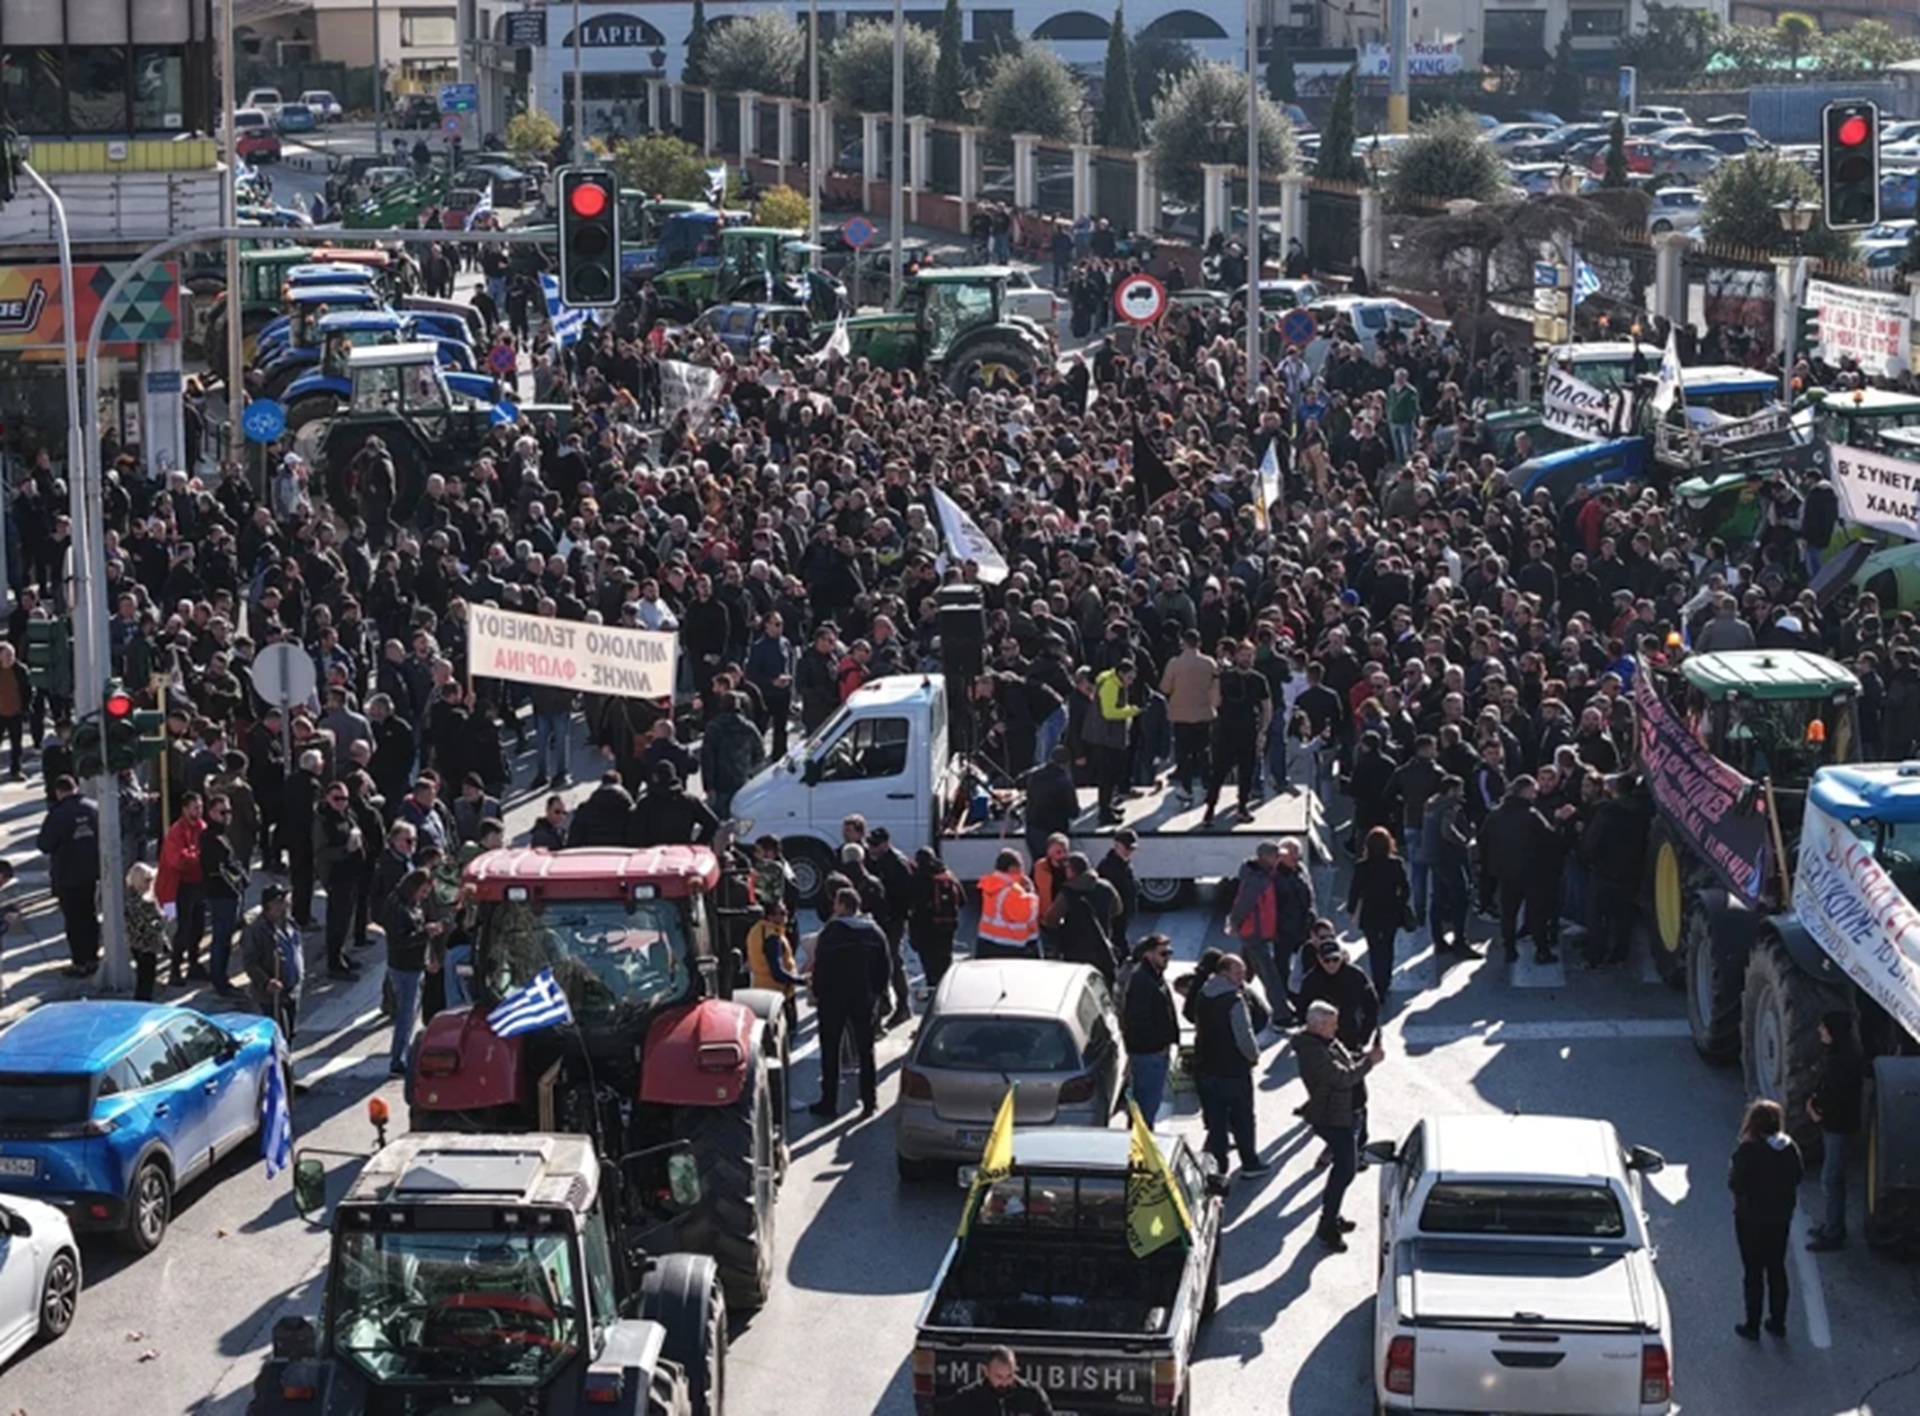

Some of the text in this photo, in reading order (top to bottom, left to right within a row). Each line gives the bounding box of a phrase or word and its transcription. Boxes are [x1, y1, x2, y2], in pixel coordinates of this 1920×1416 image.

[583, 26, 647, 44] LAPEL
[1378, 59, 1445, 73] PKING
[951, 1361, 1136, 1391] MIUBISHI
